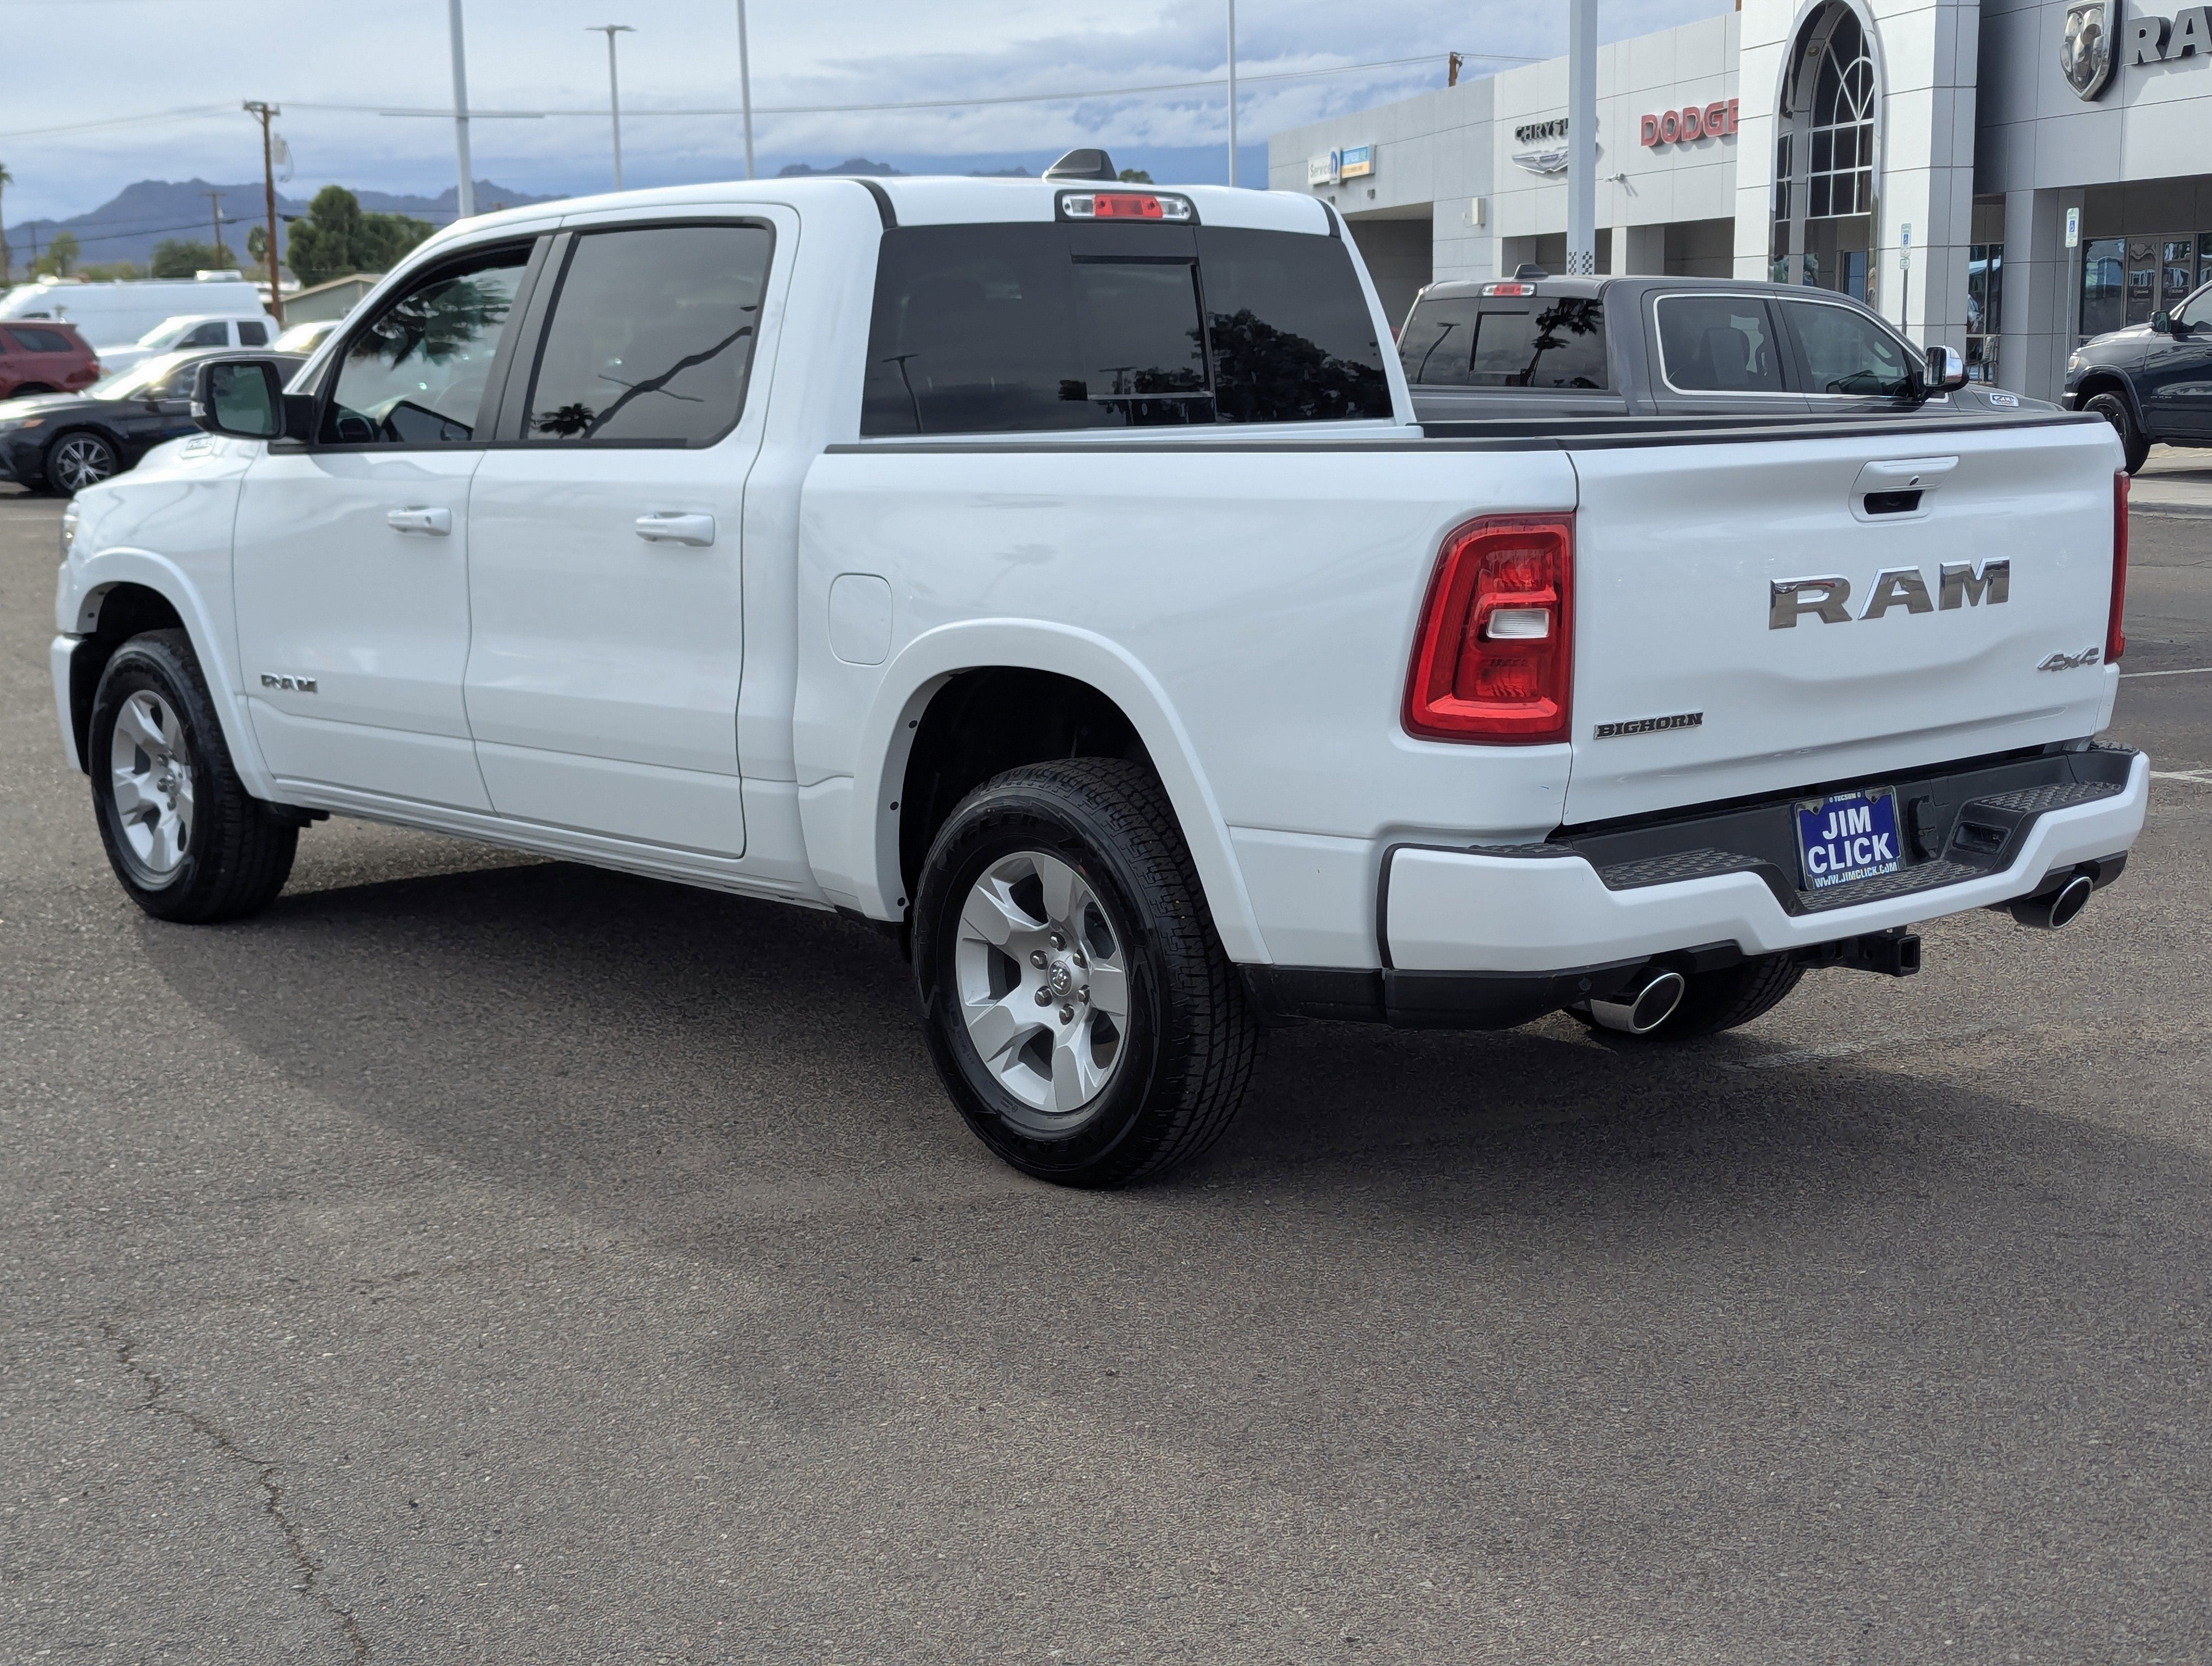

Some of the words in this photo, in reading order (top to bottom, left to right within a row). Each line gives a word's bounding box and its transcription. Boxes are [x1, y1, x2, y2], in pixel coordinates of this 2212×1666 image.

[2123, 6, 2212, 66] RA
[1515, 118, 1569, 141] CHRYSL
[1641, 98, 1739, 146] DODGE
[1769, 556, 2010, 630] RAM
[261, 671, 319, 694] RAM
[1593, 709, 1703, 740] BIGHORN
[1822, 806, 1872, 840] JIM
[1808, 832, 1893, 874] CLICK
[1814, 862, 1898, 888] WWW.JIMCLICK.COM
